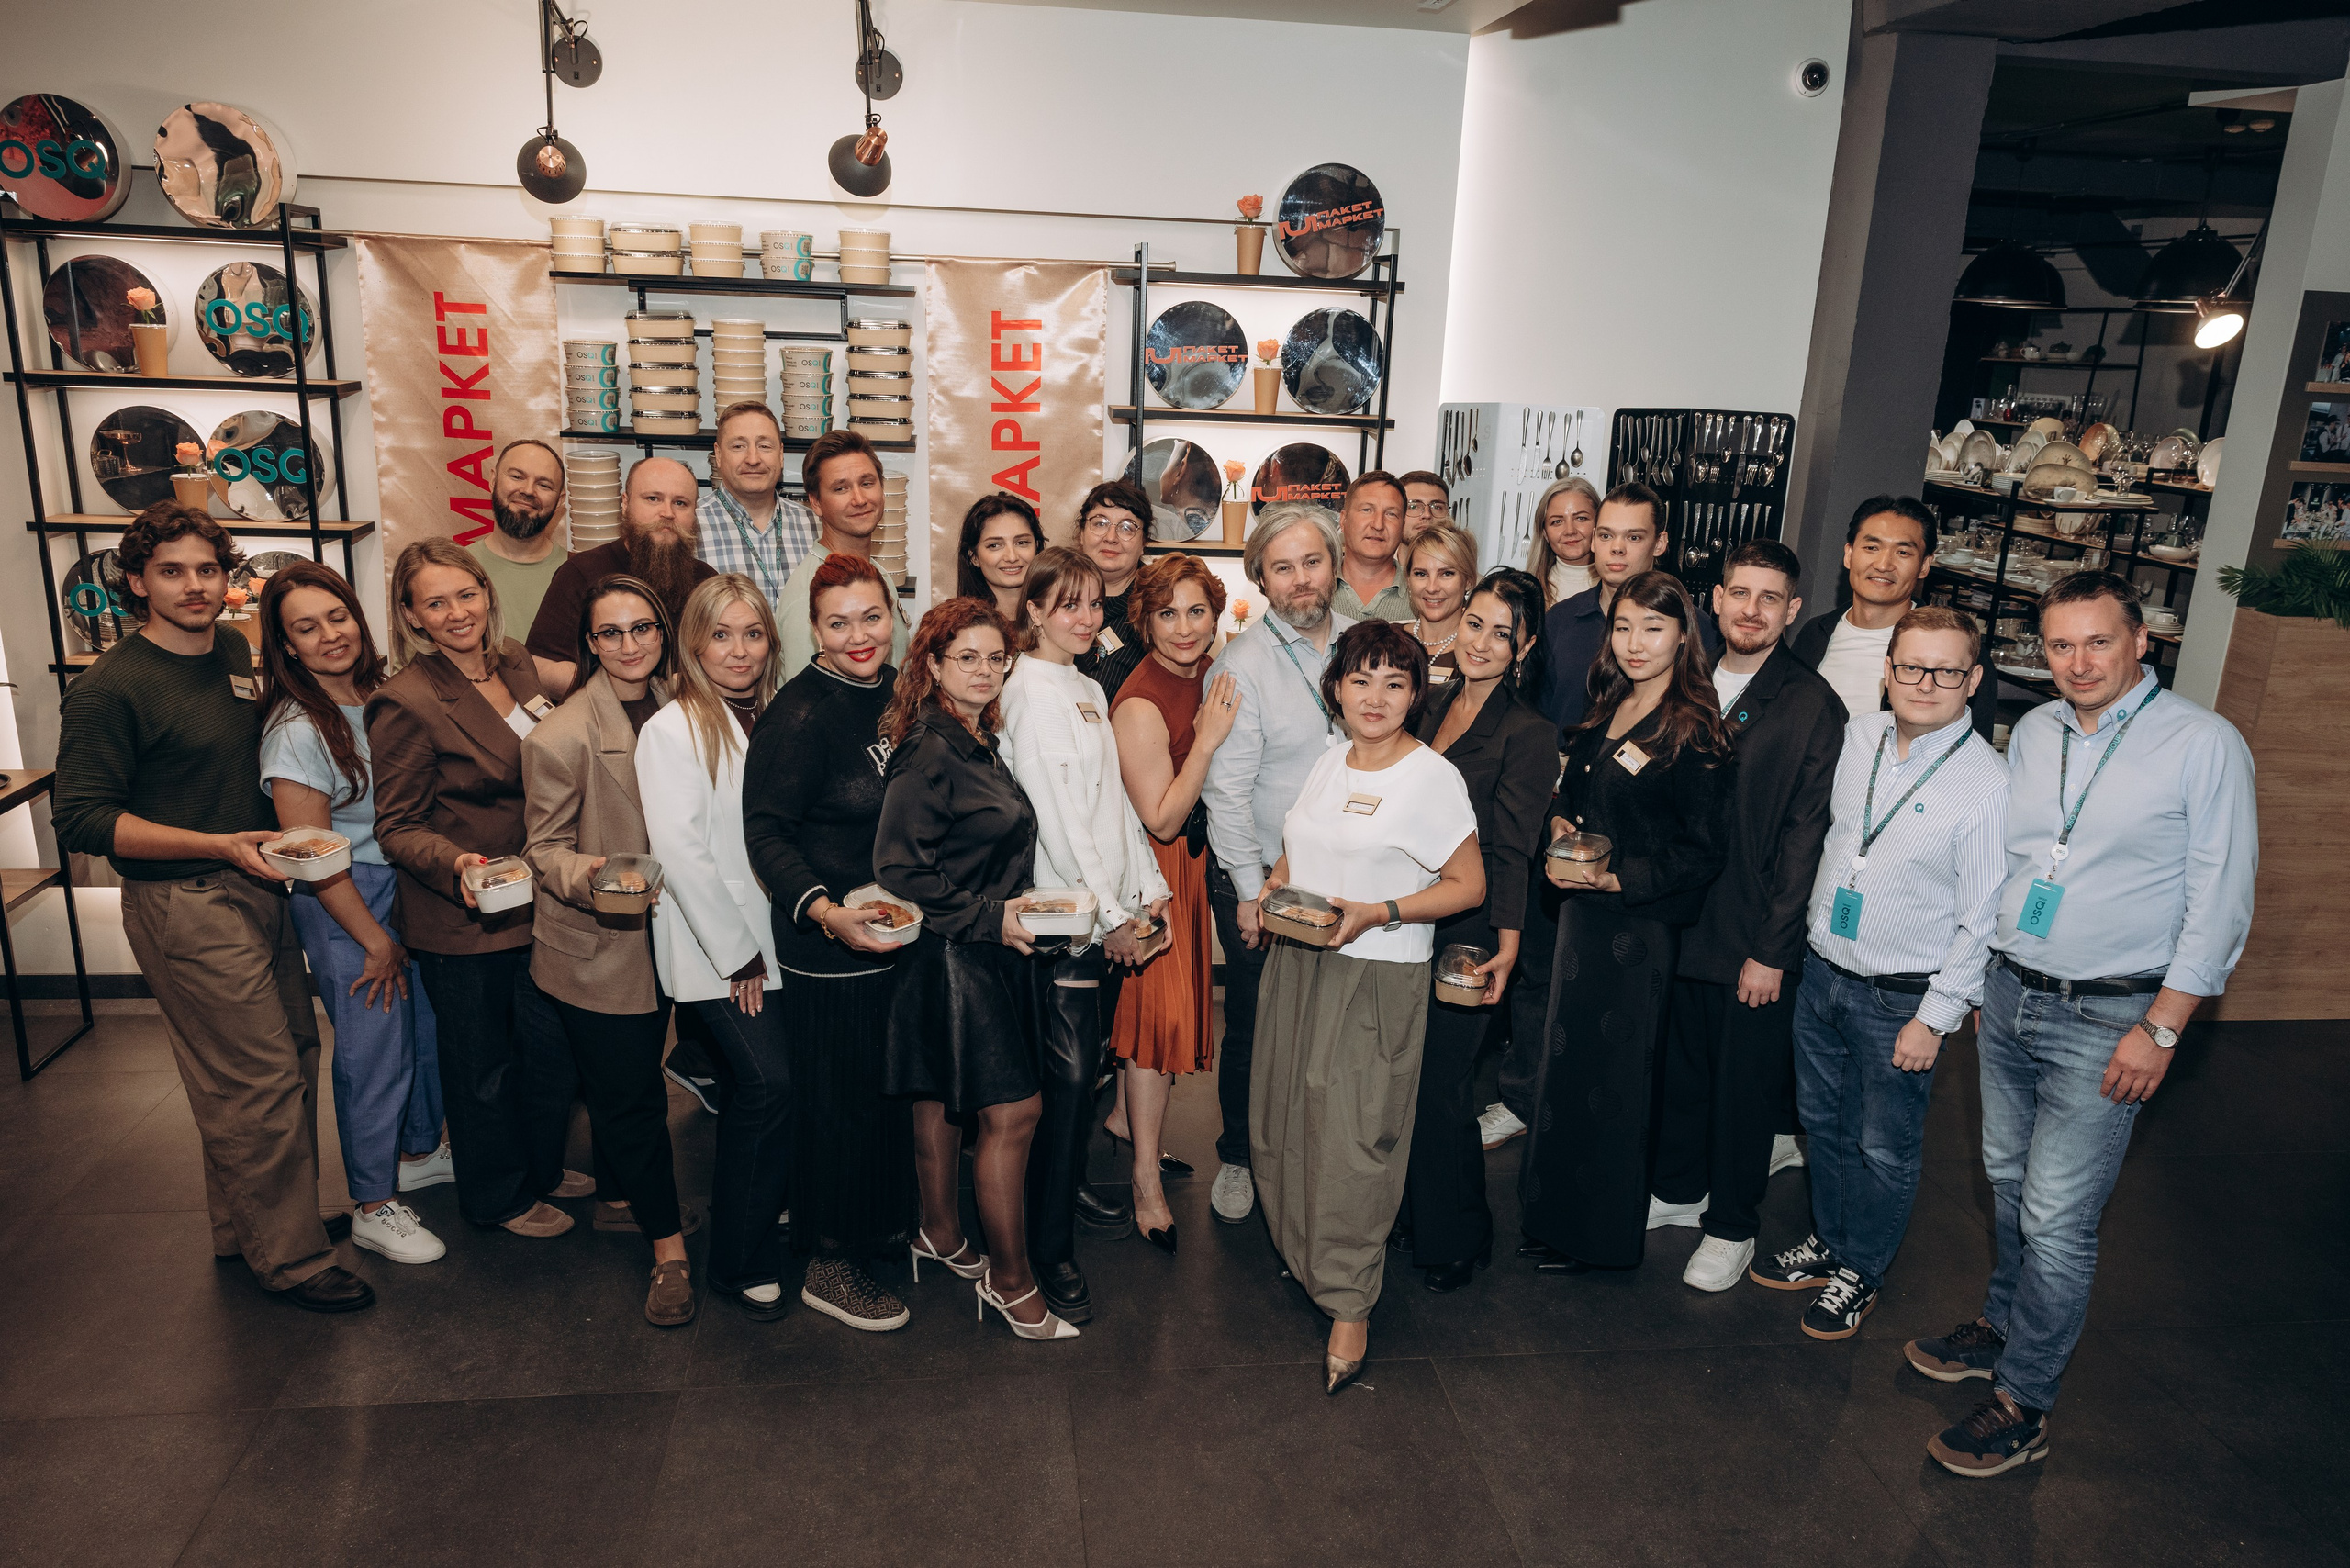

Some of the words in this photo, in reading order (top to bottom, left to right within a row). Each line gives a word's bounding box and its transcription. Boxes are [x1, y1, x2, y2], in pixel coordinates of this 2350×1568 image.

[1, 140, 108, 181] OSQ
[1316, 200, 1372, 220] ПАКЕТ
[1317, 208, 1384, 230] МАРКЕТ
[773, 241, 790, 250] OSQ
[205, 298, 310, 343] OSQ
[1183, 345, 1238, 353] ПАКЕТ
[1183, 354, 1248, 363] МАРКЕТ
[577, 418, 595, 426] OSQ
[991, 310, 1042, 517] АРКЕТ
[214, 447, 308, 483] OSQ
[1288, 483, 1341, 491] ПАКЕТ
[2105, 734, 2121, 757] GROUP
[1933, 756, 1947, 768] OSQ
[1915, 767, 1934, 788] GROUP
[1876, 812, 1893, 833] GROUP
[2065, 814, 2076, 830] OSQ
[1840, 907, 1851, 929] OSQ
[2030, 901, 2046, 925] OSQ
